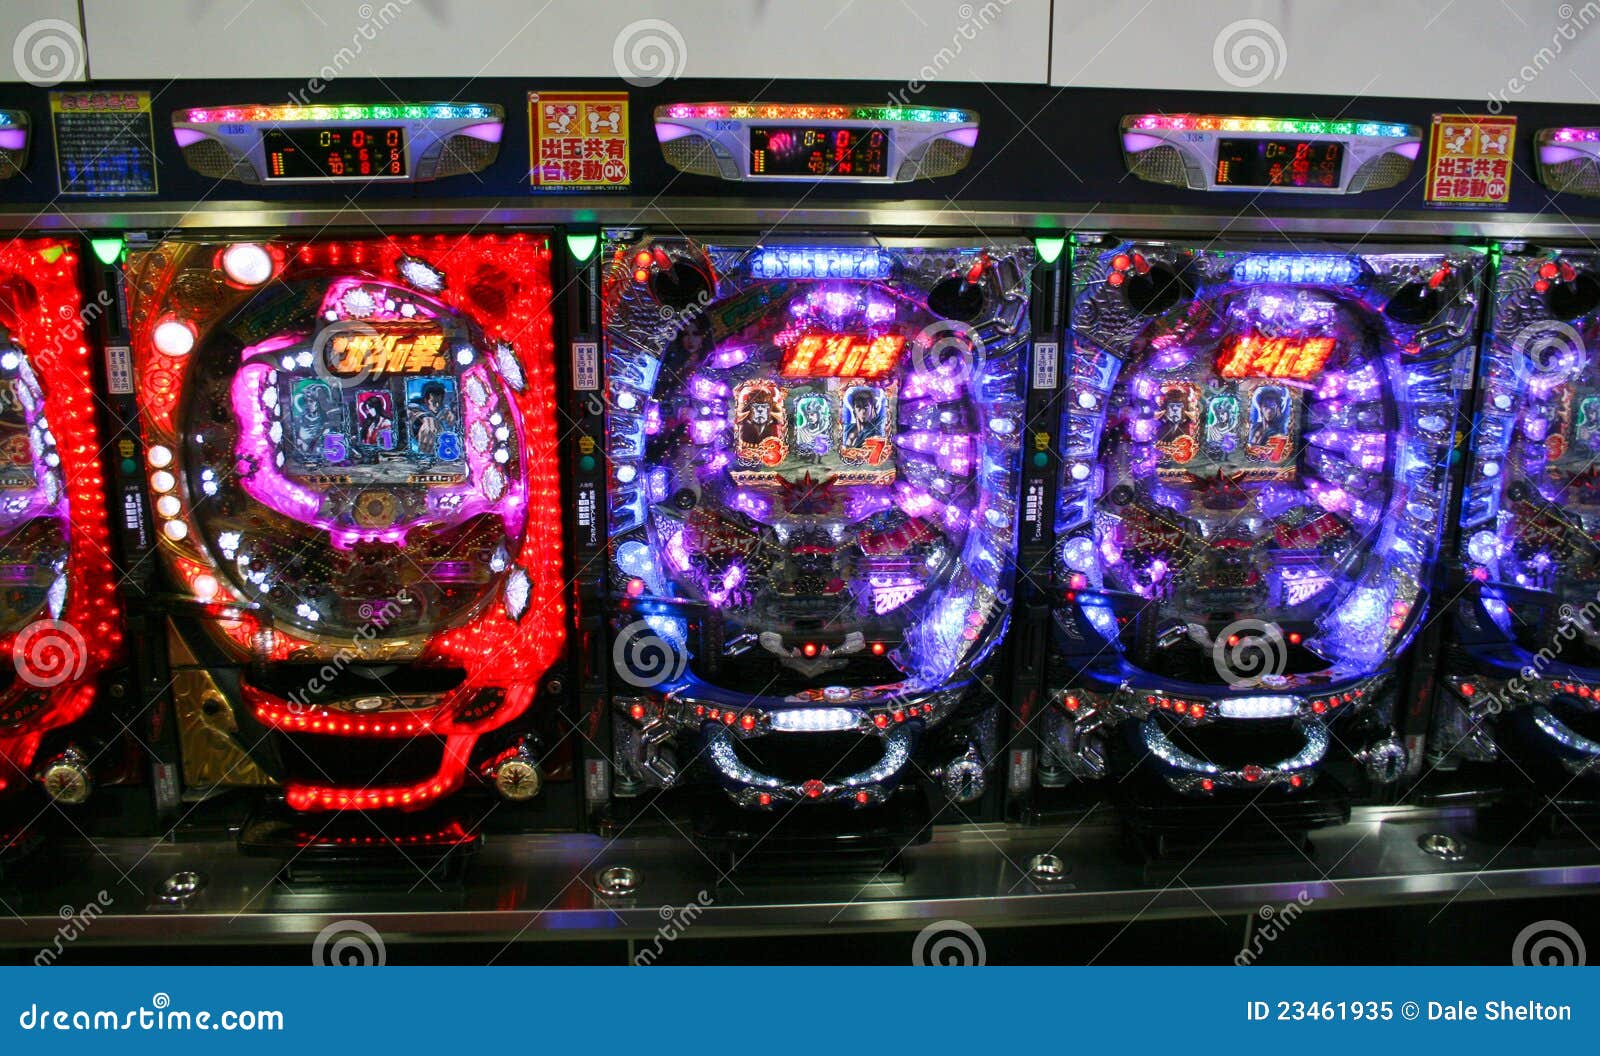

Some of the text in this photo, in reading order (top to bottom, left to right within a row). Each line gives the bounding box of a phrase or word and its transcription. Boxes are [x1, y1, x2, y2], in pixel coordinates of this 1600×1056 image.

[541, 138, 625, 159] 出玉共有
[1437, 157, 1509, 178] 出玉共有
[323, 430, 461, 462] 5 1 8
[760, 437, 783, 467] 3
[863, 437, 887, 466] 7
[1172, 435, 1193, 463] 3
[1267, 436, 1287, 463] 7
